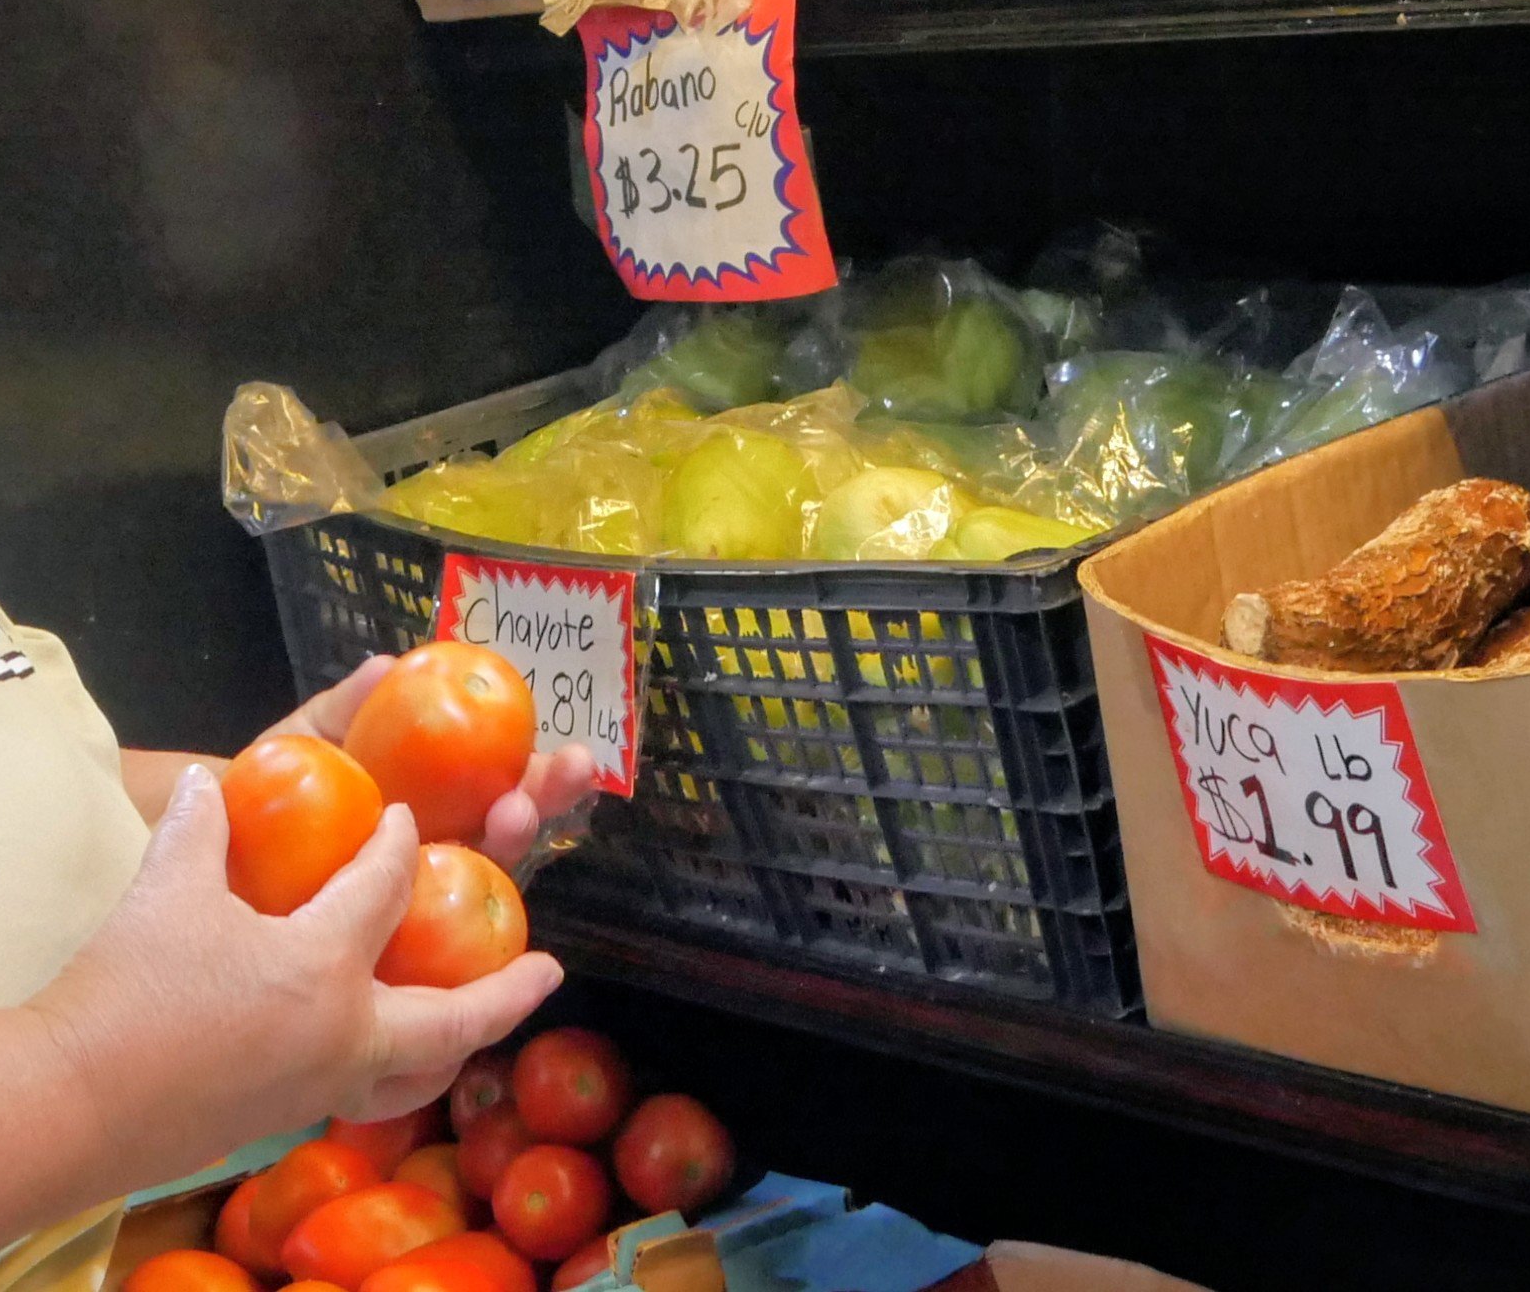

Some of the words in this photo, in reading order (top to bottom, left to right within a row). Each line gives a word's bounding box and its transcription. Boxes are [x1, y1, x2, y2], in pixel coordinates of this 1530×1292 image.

[609, 52, 716, 127] Rabano
[615, 143, 747, 219] $3.25
[464, 586, 595, 653] Chayote
[1198, 766, 1398, 889] $1.99
